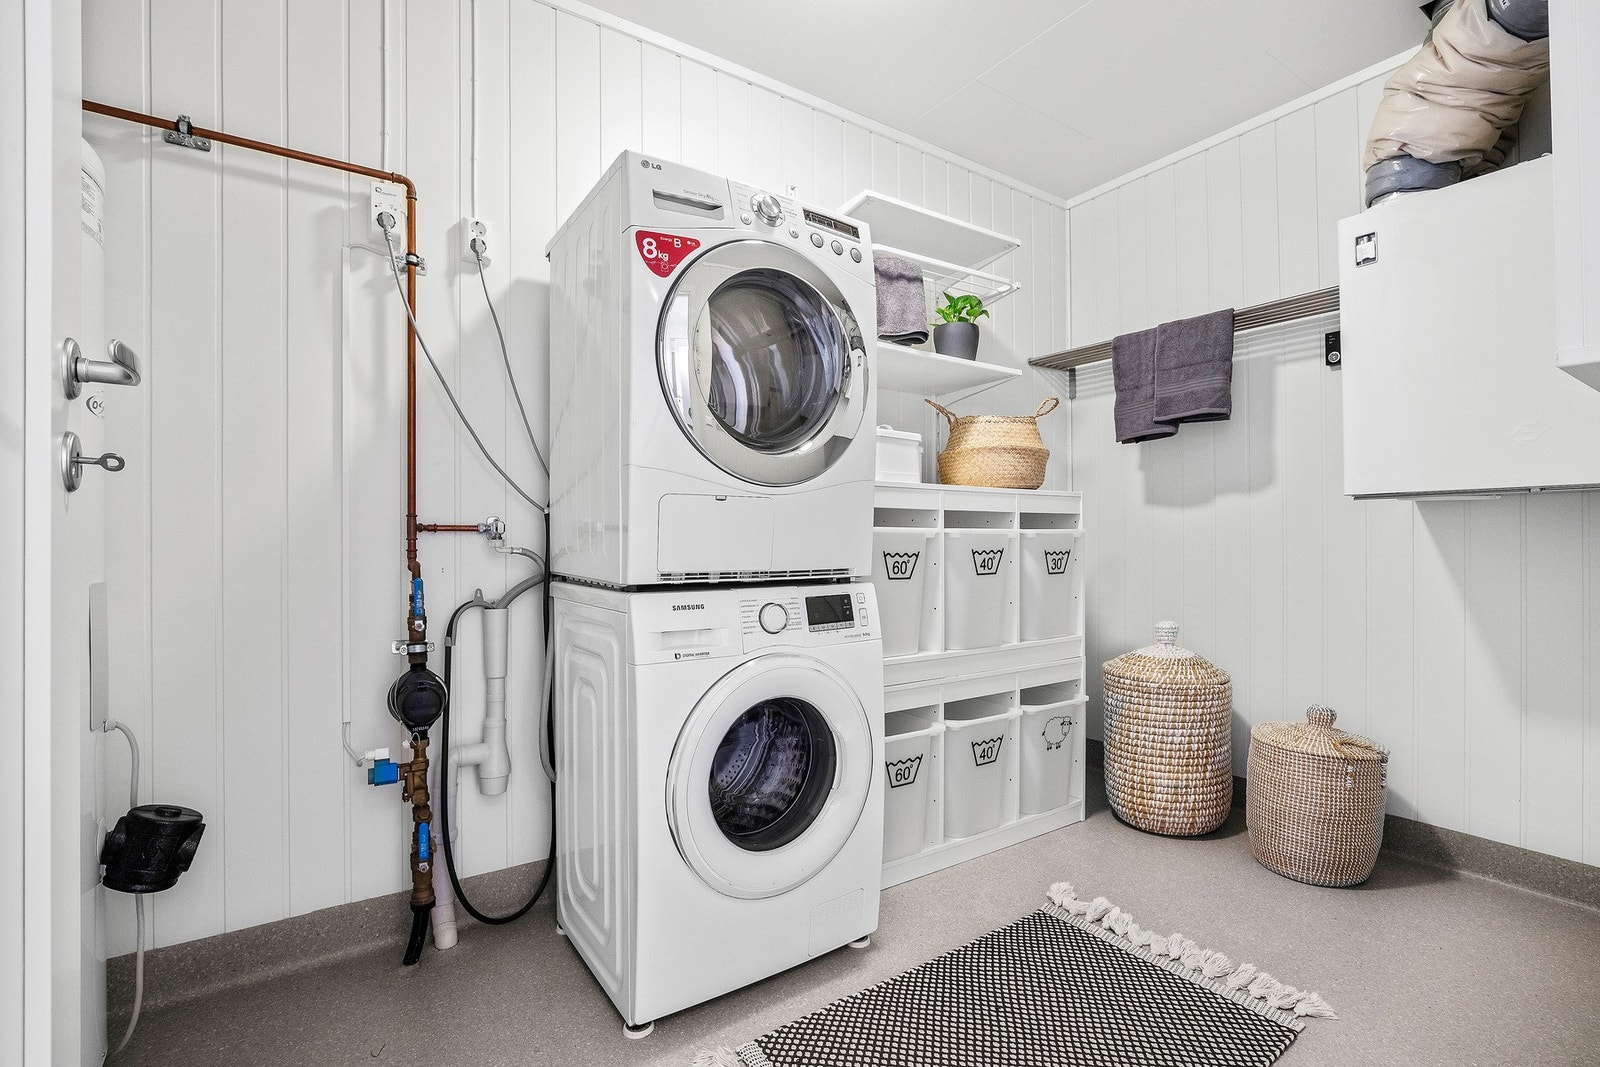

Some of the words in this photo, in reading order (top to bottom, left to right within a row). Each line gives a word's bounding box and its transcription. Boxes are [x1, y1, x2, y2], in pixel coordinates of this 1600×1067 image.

[651, 162, 662, 171] LG
[673, 237, 682, 248] B
[642, 237, 658, 259] 8
[658, 250, 669, 262] kg
[672, 603, 705, 611] SAMSUNG
